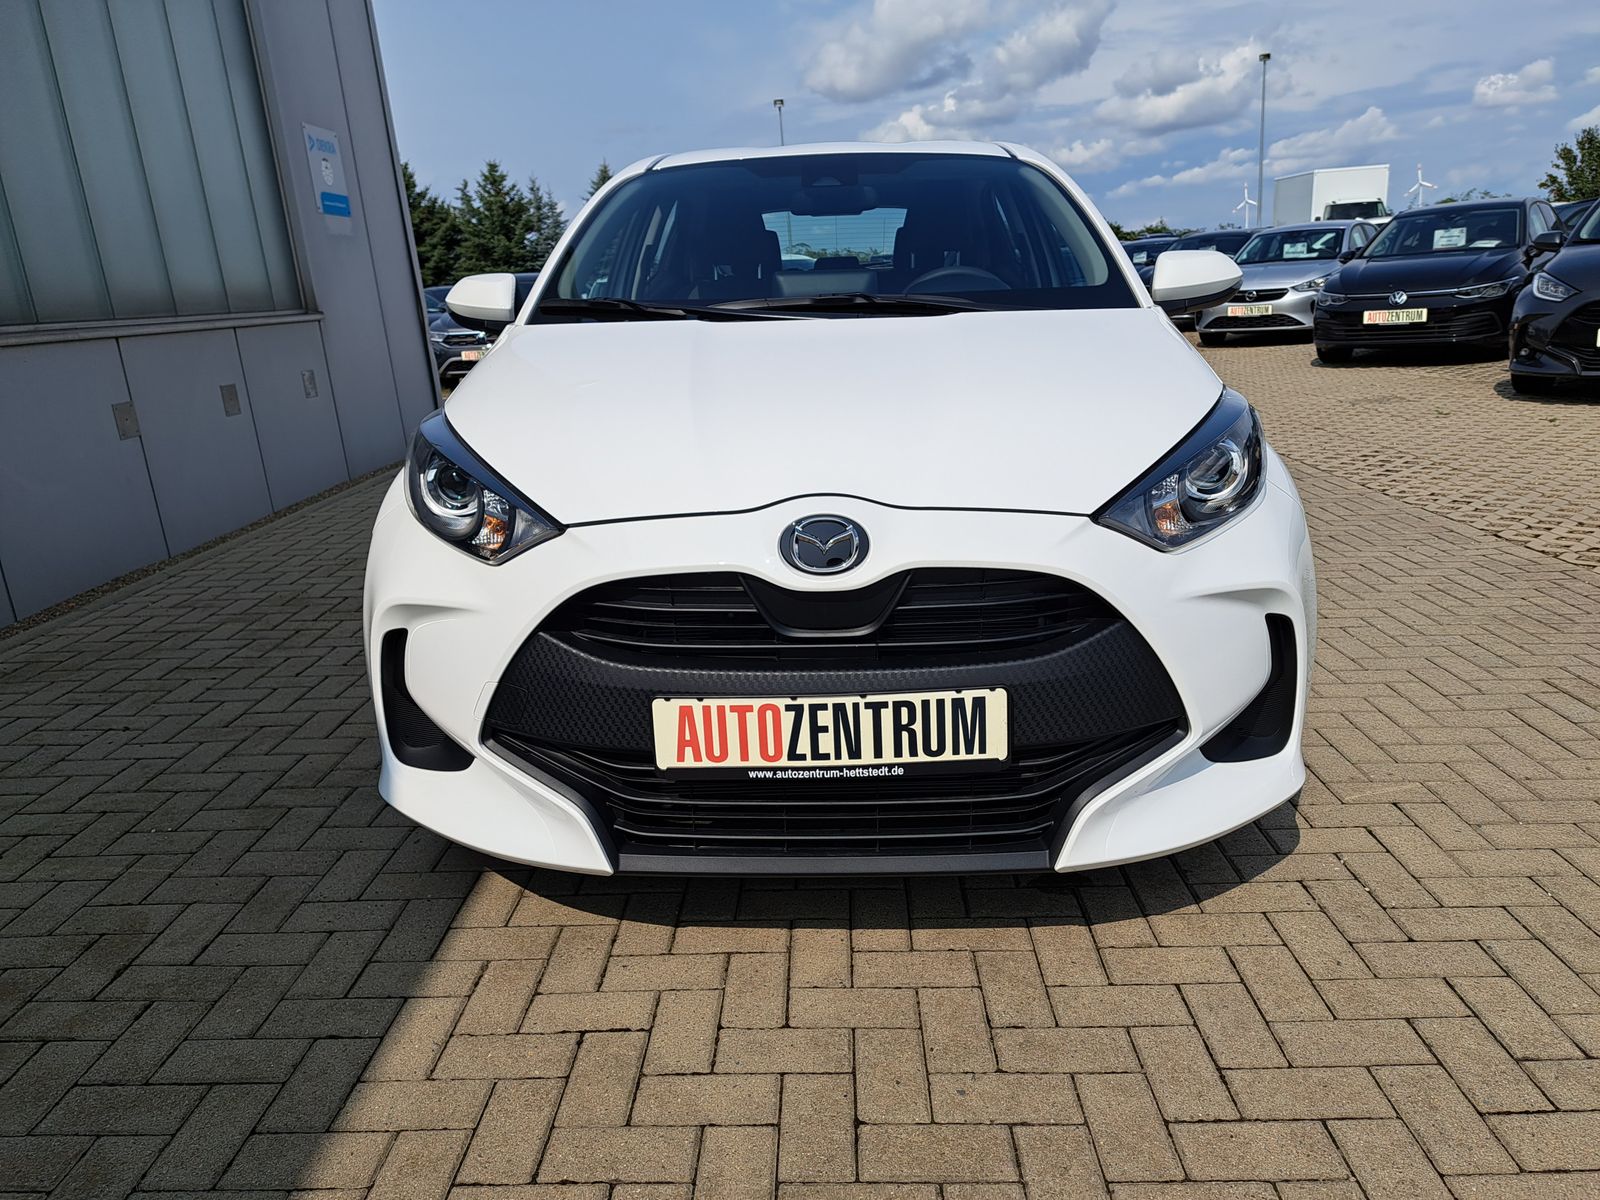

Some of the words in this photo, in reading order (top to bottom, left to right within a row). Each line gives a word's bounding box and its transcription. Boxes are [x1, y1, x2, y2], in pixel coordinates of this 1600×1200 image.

[1367, 310, 1423, 322] AUTOZENTRUM
[676, 696, 988, 763] AUTOZENTRUM
[748, 766, 904, 780] www.autozentrum-hettstedt.de
